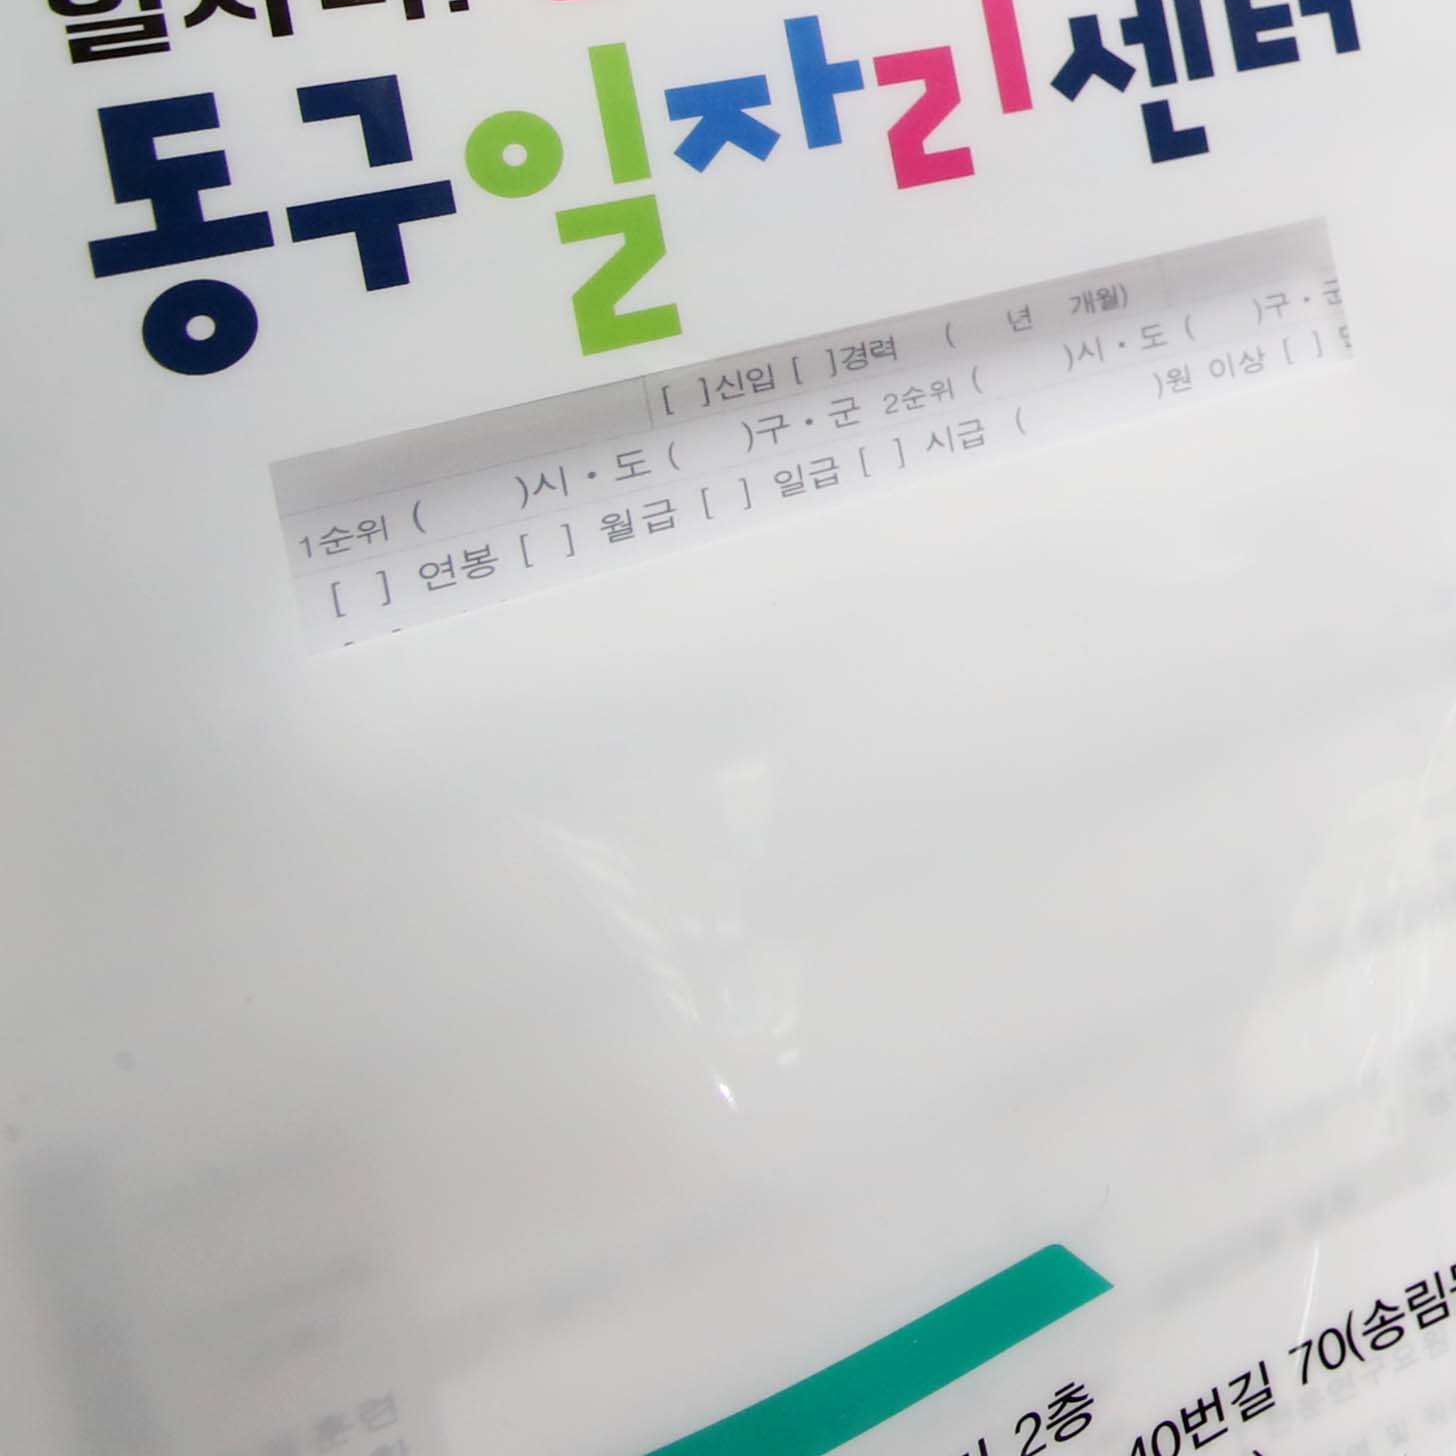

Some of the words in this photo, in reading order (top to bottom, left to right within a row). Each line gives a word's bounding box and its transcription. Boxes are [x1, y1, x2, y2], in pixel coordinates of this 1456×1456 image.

[417, 543, 500, 591] 연봉
[600, 499, 678, 544] 월급
[772, 456, 841, 499] 일급
[925, 419, 986, 454] 시급
[1209, 346, 1266, 379] 이상
[1015, 1382, 1094, 1456] 2층
